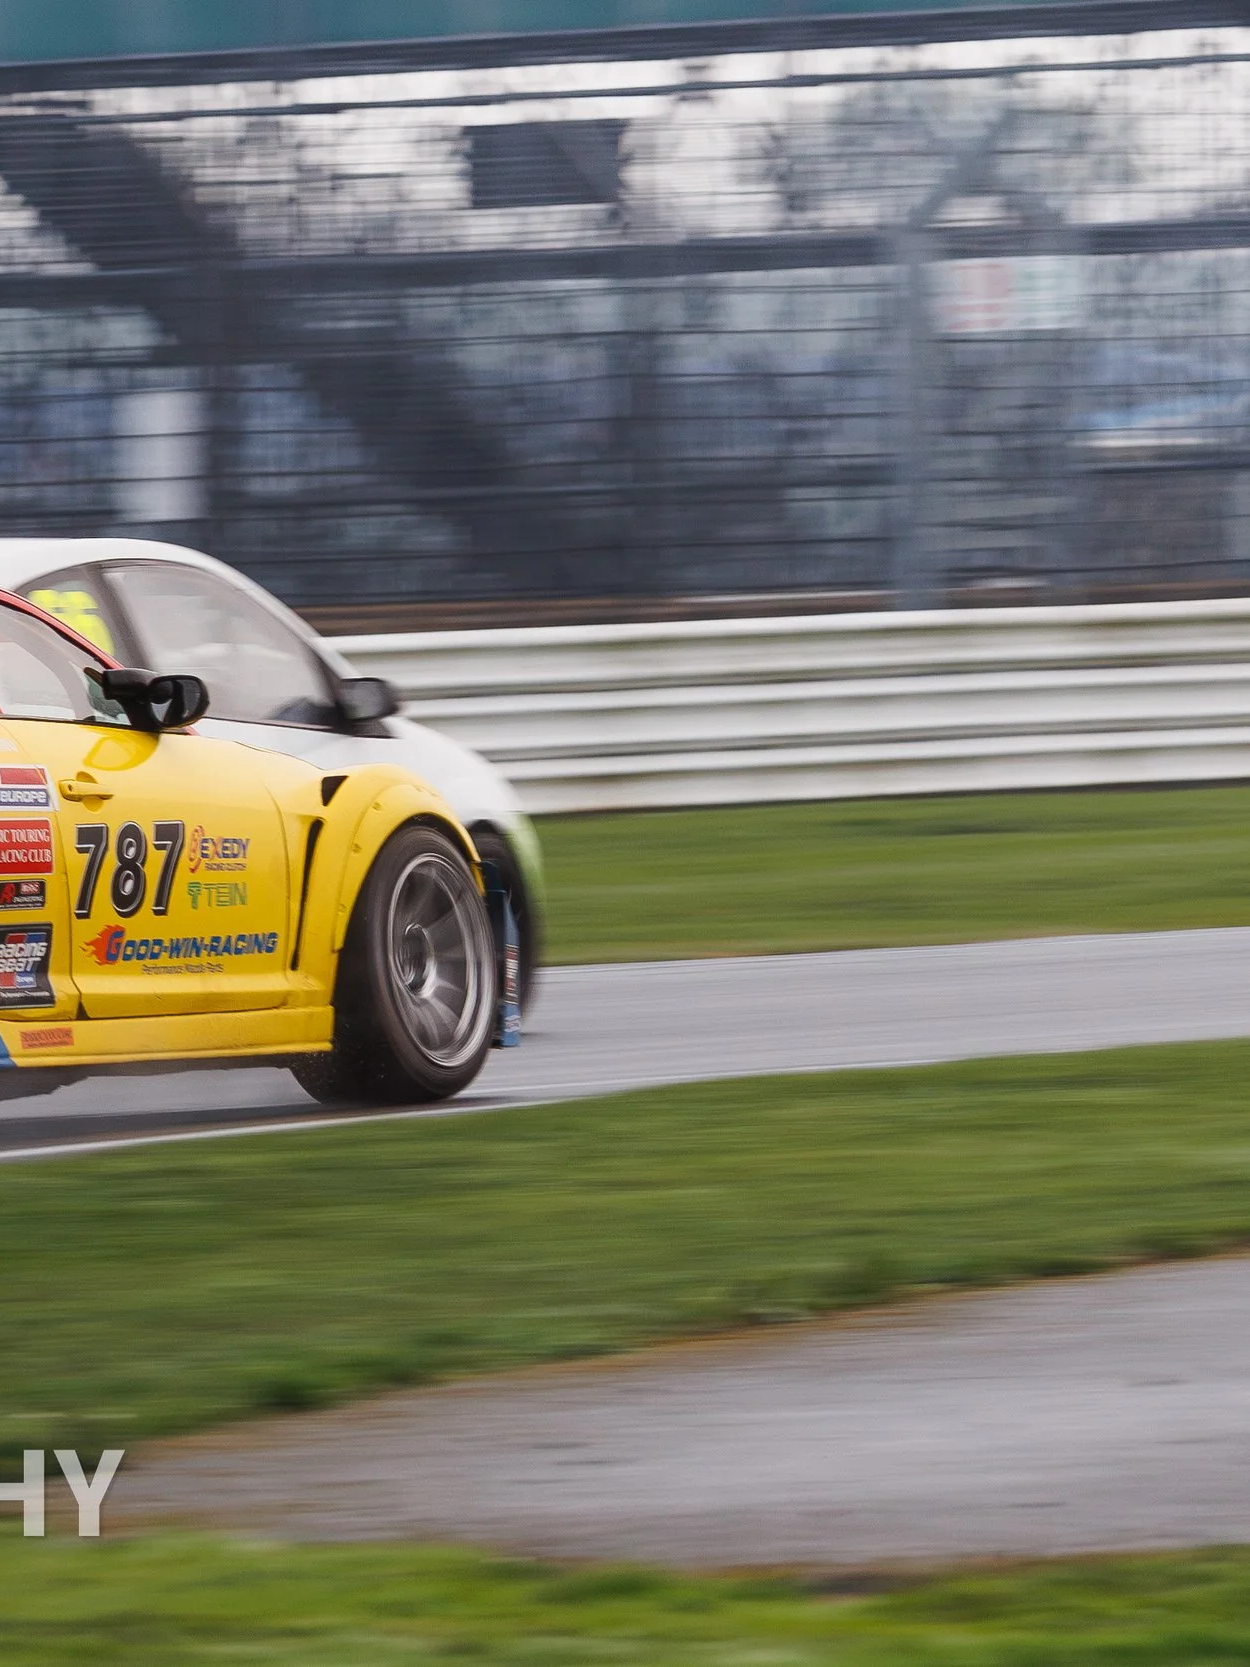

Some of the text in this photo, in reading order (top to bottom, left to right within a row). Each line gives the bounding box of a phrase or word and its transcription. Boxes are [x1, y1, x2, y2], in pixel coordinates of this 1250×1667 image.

[10, 828, 51, 843] TOURING
[28, 848, 52, 863] CLUB
[200, 837, 250, 860] EXEDY
[73, 819, 185, 919] 787
[202, 881, 248, 907] TEIN
